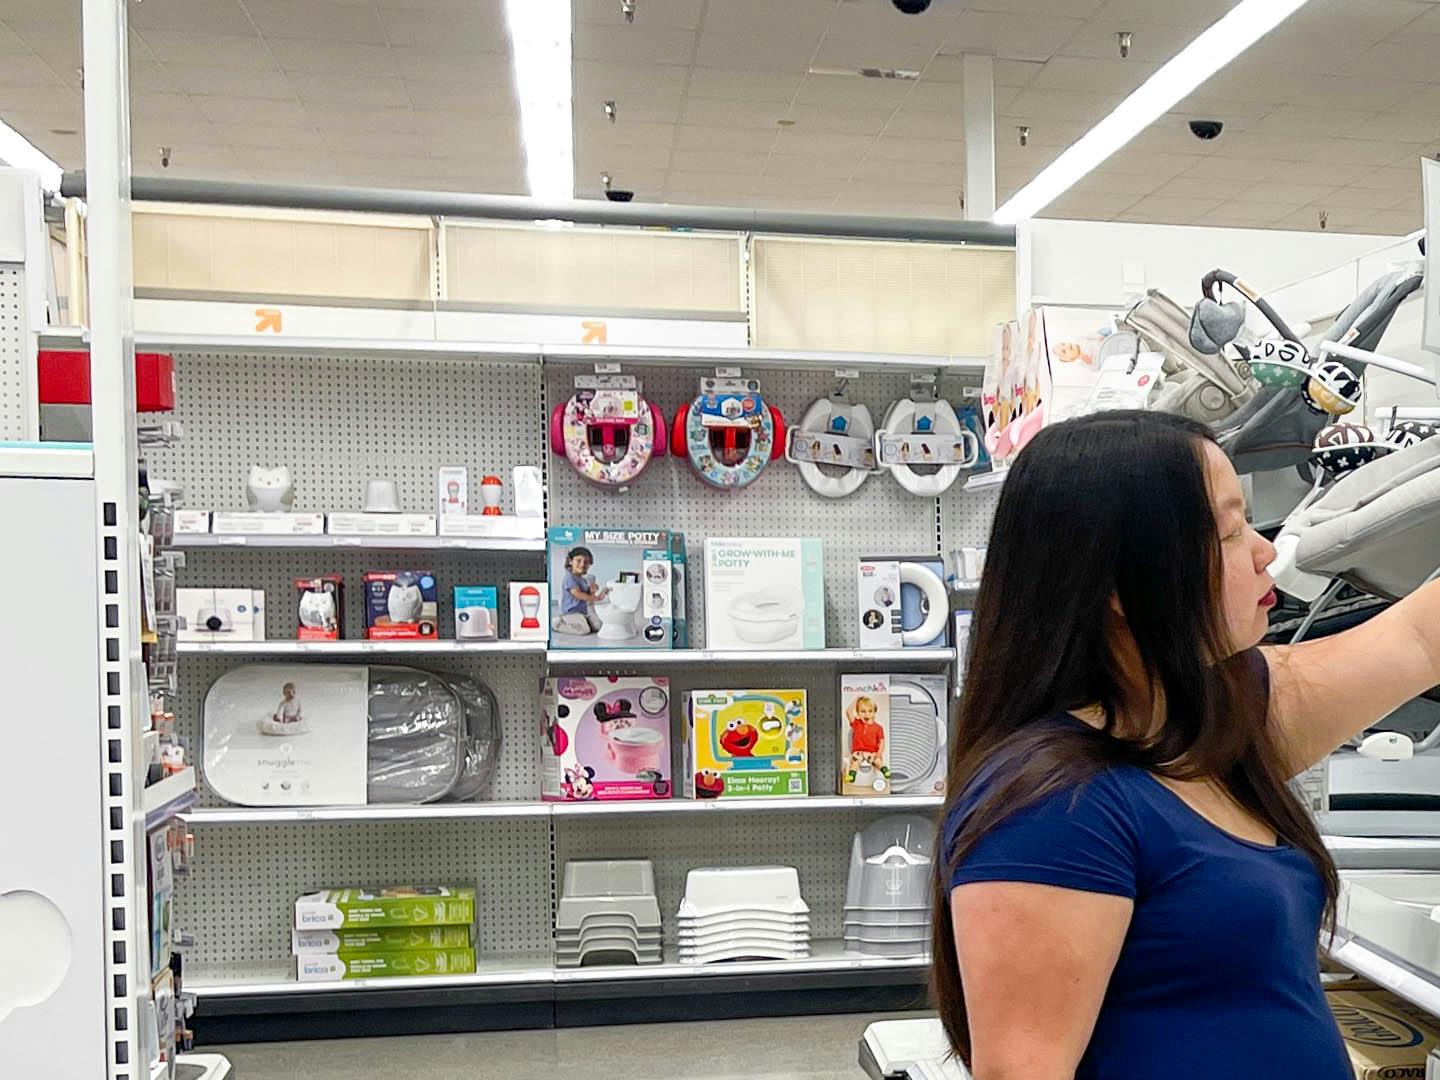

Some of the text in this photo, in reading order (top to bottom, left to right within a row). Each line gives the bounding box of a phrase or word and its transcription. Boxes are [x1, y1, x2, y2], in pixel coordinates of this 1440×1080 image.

[584, 531, 660, 541] MY SIZE POTTY
[718, 559, 750, 568] POTTY
[843, 682, 887, 693] munchkin
